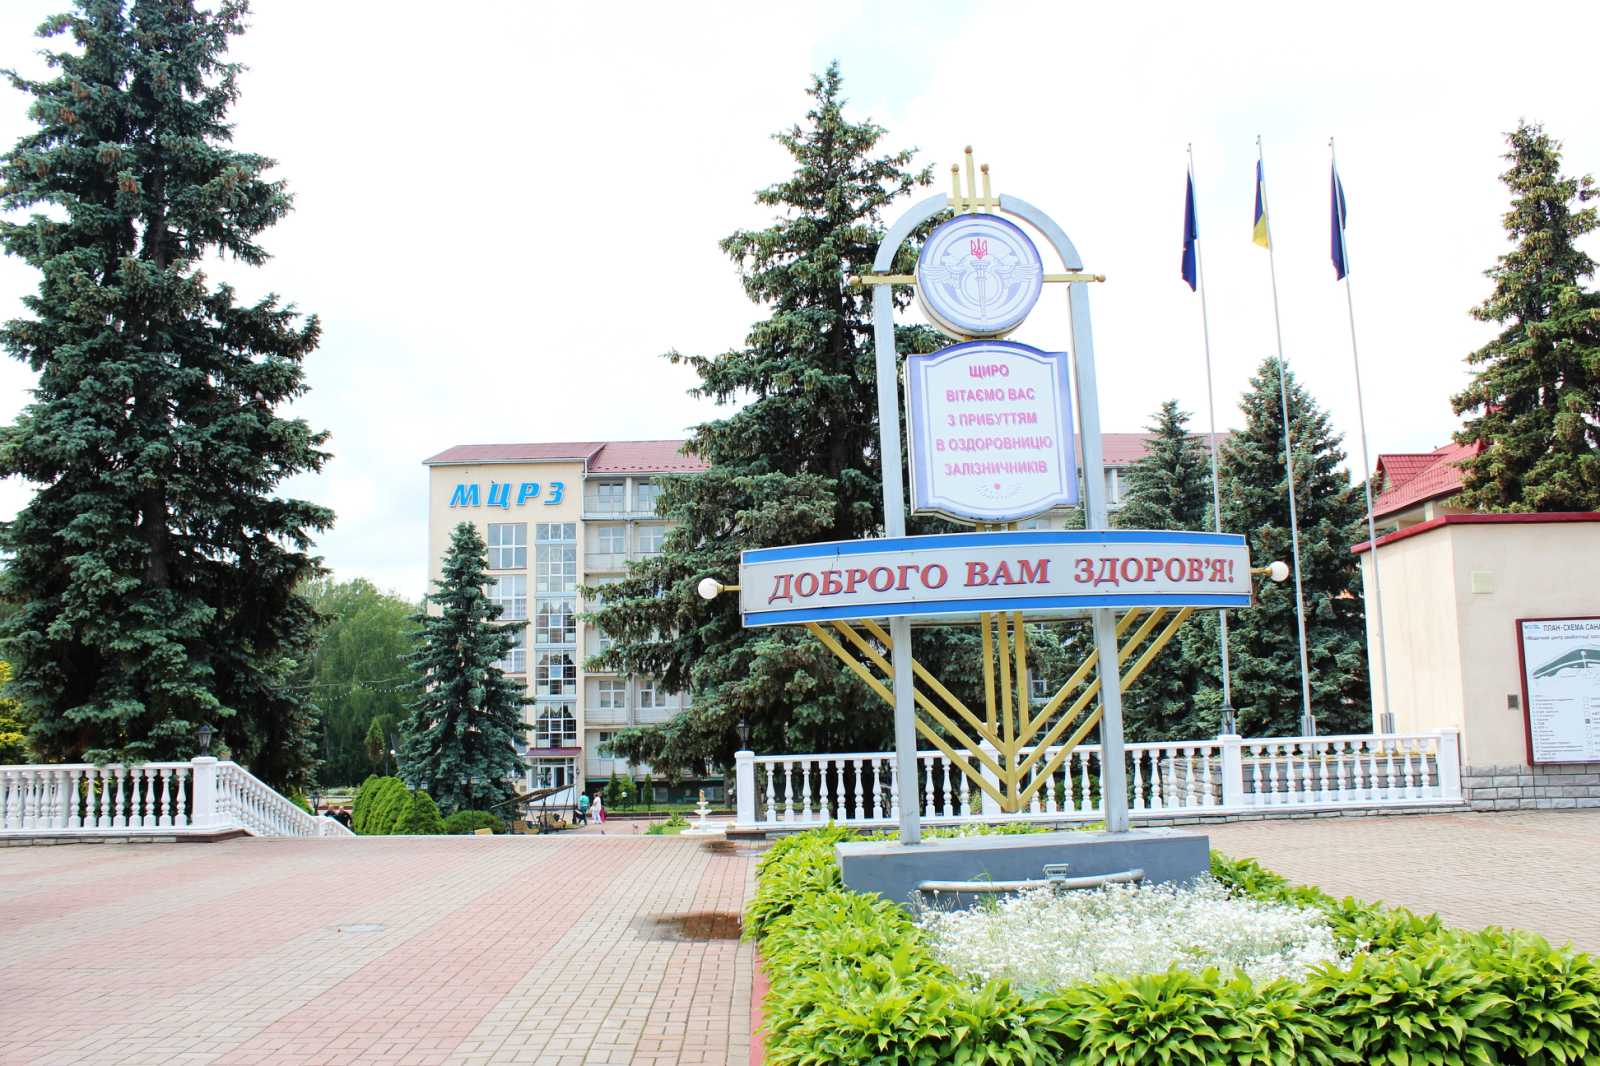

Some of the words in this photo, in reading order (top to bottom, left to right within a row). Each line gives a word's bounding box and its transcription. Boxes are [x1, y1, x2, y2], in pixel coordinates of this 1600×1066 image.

[969, 364, 1010, 379] ЩИРО
[946, 388, 1005, 402] ВІТАЄМО
[1008, 387, 1036, 401] ВАС
[947, 414, 956, 426] З
[959, 412, 1038, 426] ПРИБУТТЯМ
[936, 438, 945, 452] В
[948, 436, 1053, 453] ОЗДОРОВНИЦЮ
[944, 460, 1048, 476] ЗАЛІЗНИЧНИКІВ
[449, 480, 566, 510] МЦРЗ
[768, 563, 948, 605] ДОБРОГО
[963, 558, 1051, 587] ВАМ
